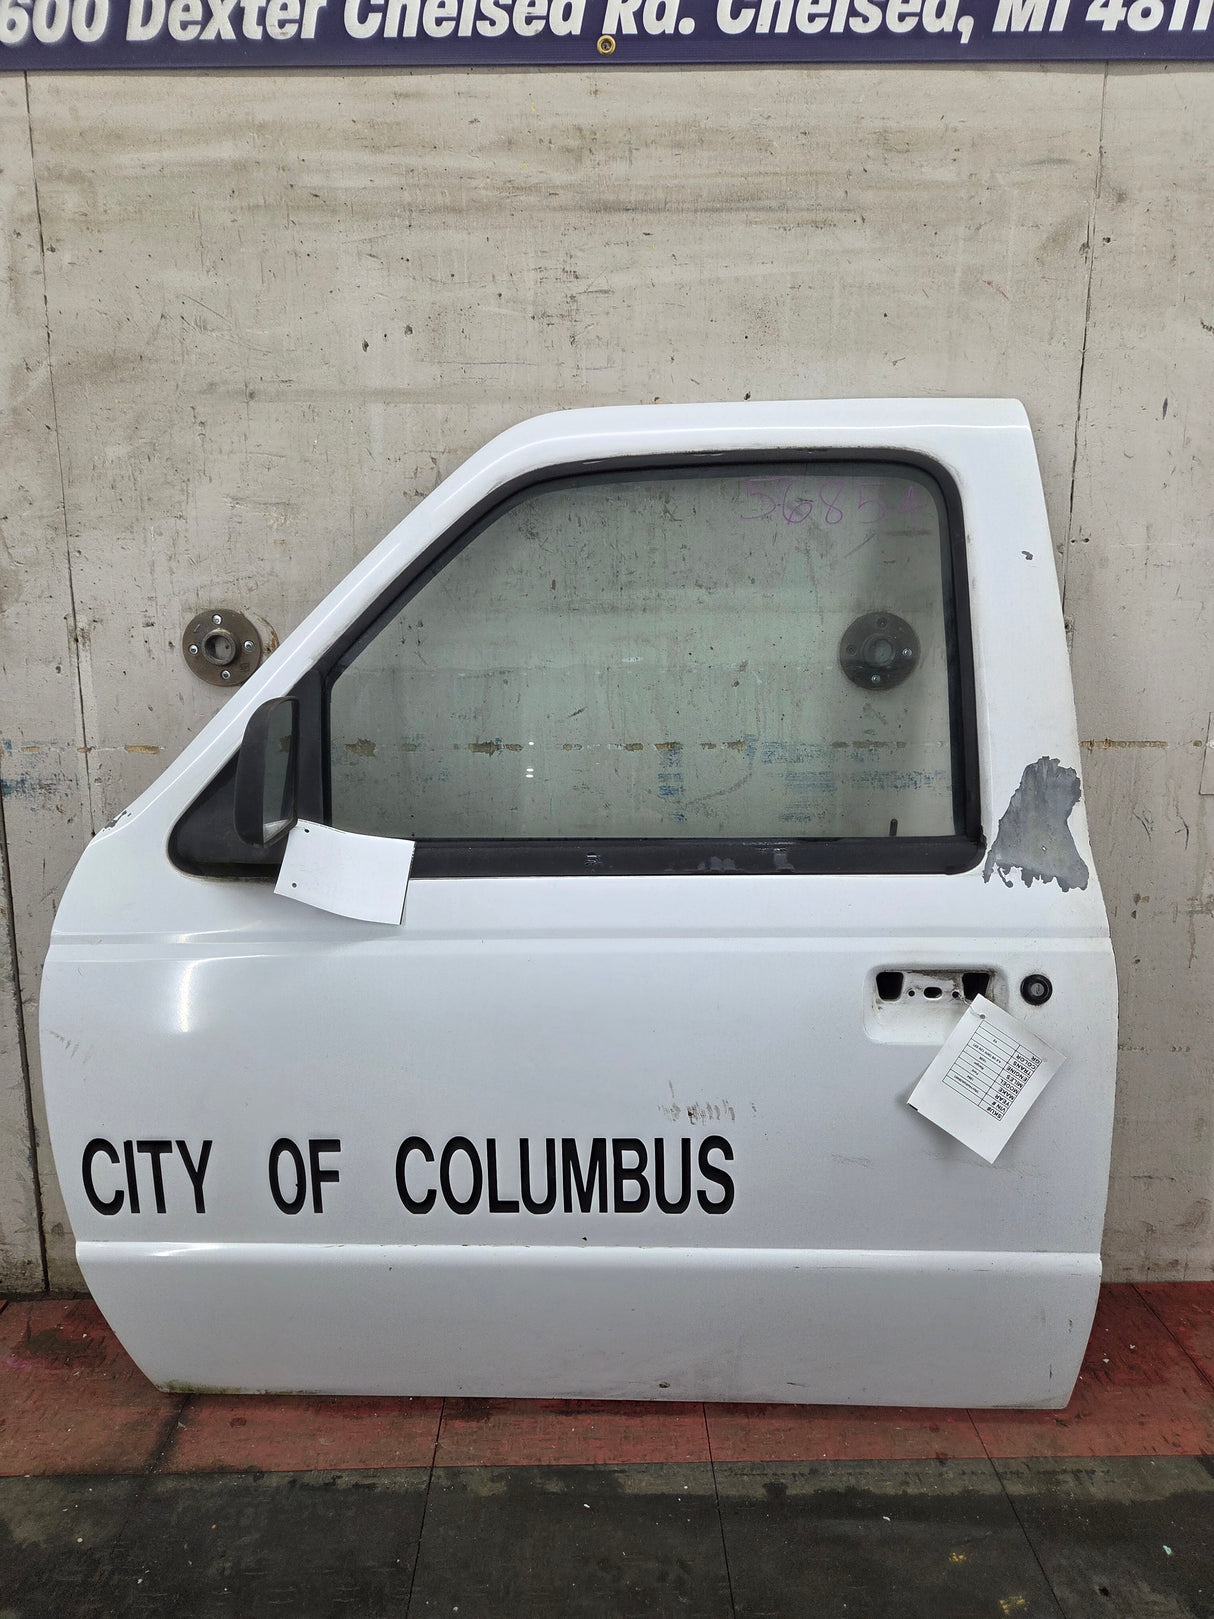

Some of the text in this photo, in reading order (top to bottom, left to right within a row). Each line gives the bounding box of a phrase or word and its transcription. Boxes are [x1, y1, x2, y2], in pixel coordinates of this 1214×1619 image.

[126, 0, 326, 41] Dexter
[343, 0, 586, 39] Chelsea
[601, 0, 696, 36] Rd.
[716, 0, 974, 44] Chelsea,
[992, 0, 1071, 32] MI
[1015, 1053, 1036, 1070] COLOR
[1030, 1055, 1040, 1064] GR
[1005, 1065, 1028, 1082] ENGINE
[1011, 1060, 1032, 1076] TRANS
[998, 1078, 1019, 1094] MODEL
[1005, 1073, 1024, 1088] MILES
[994, 1093, 1010, 1106] YEAR
[997, 1086, 1015, 1100] MAKE
[985, 1105, 1002, 1119] SKU#
[995, 1103, 1006, 1113] VIN
[82, 1136, 734, 1215] CITY OF COLUMBUS
